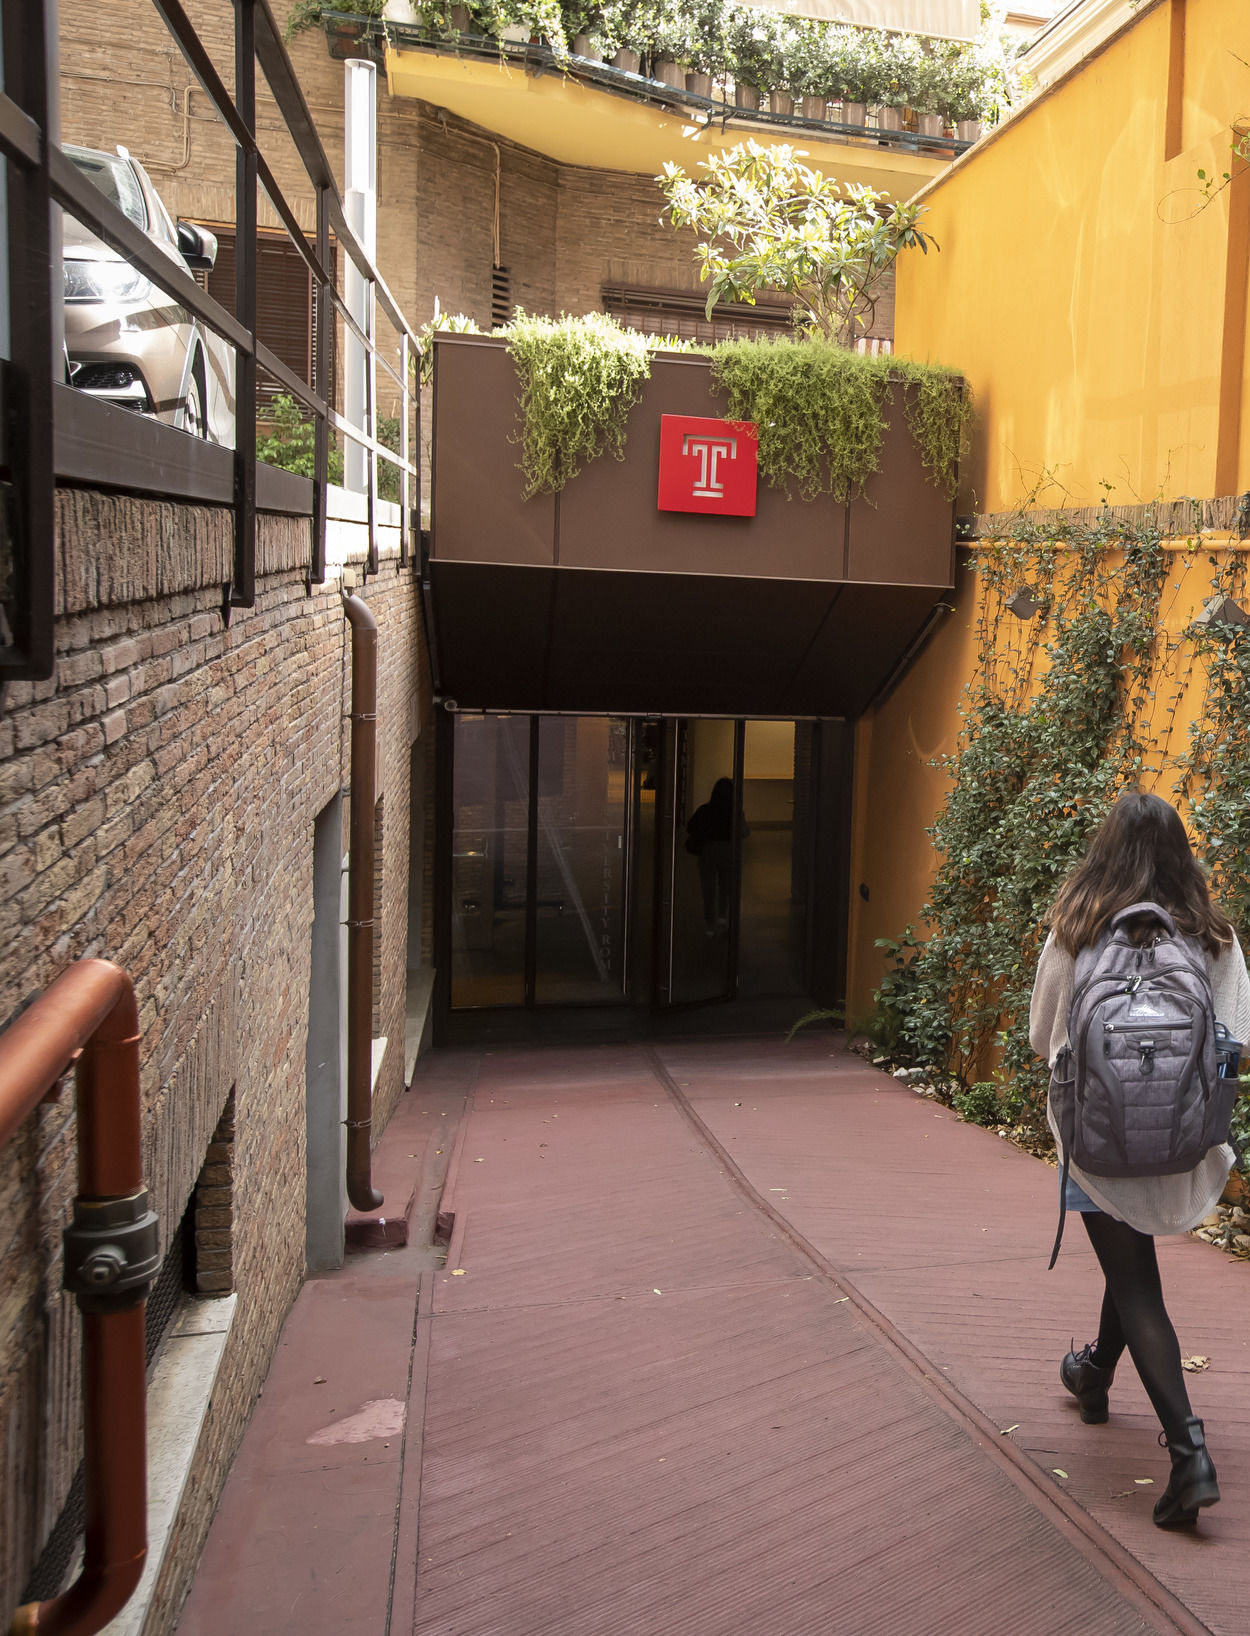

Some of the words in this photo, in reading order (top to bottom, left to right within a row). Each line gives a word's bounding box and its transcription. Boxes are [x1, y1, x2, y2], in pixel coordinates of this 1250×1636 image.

[682, 433, 737, 498] T
[601, 807, 613, 928] IVERSITY
[600, 934, 611, 981] ROM
